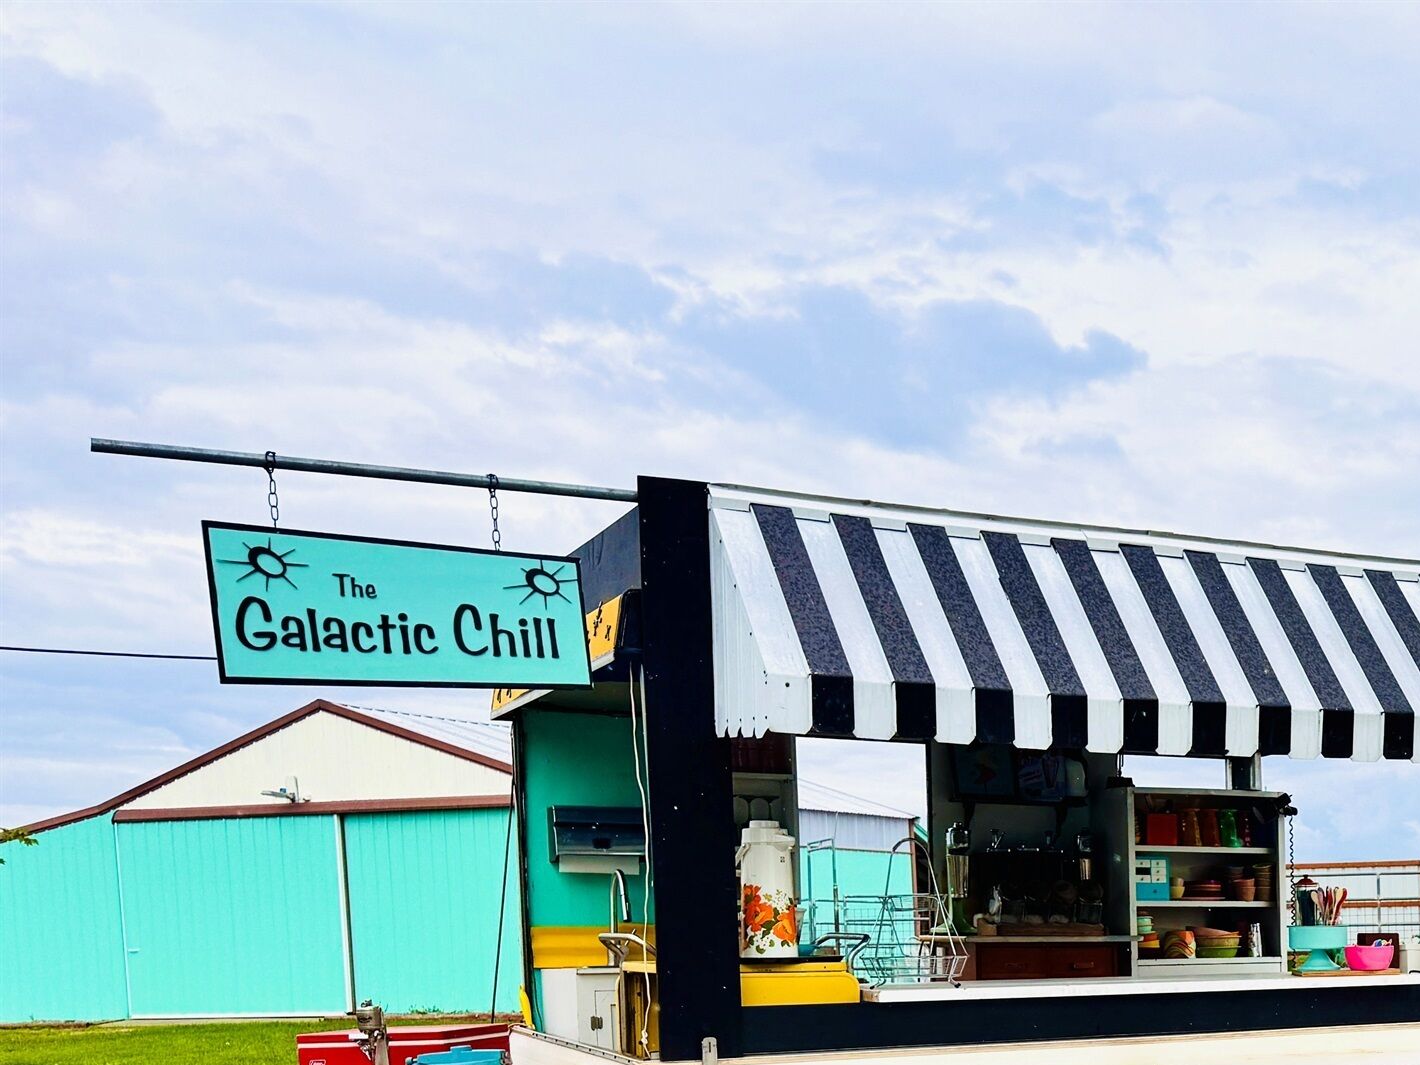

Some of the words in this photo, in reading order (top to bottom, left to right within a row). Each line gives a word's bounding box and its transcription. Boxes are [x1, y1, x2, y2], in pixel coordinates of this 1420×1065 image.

[331, 573, 378, 600] The
[235, 596, 440, 655] Galactic
[453, 603, 561, 659] Chill
